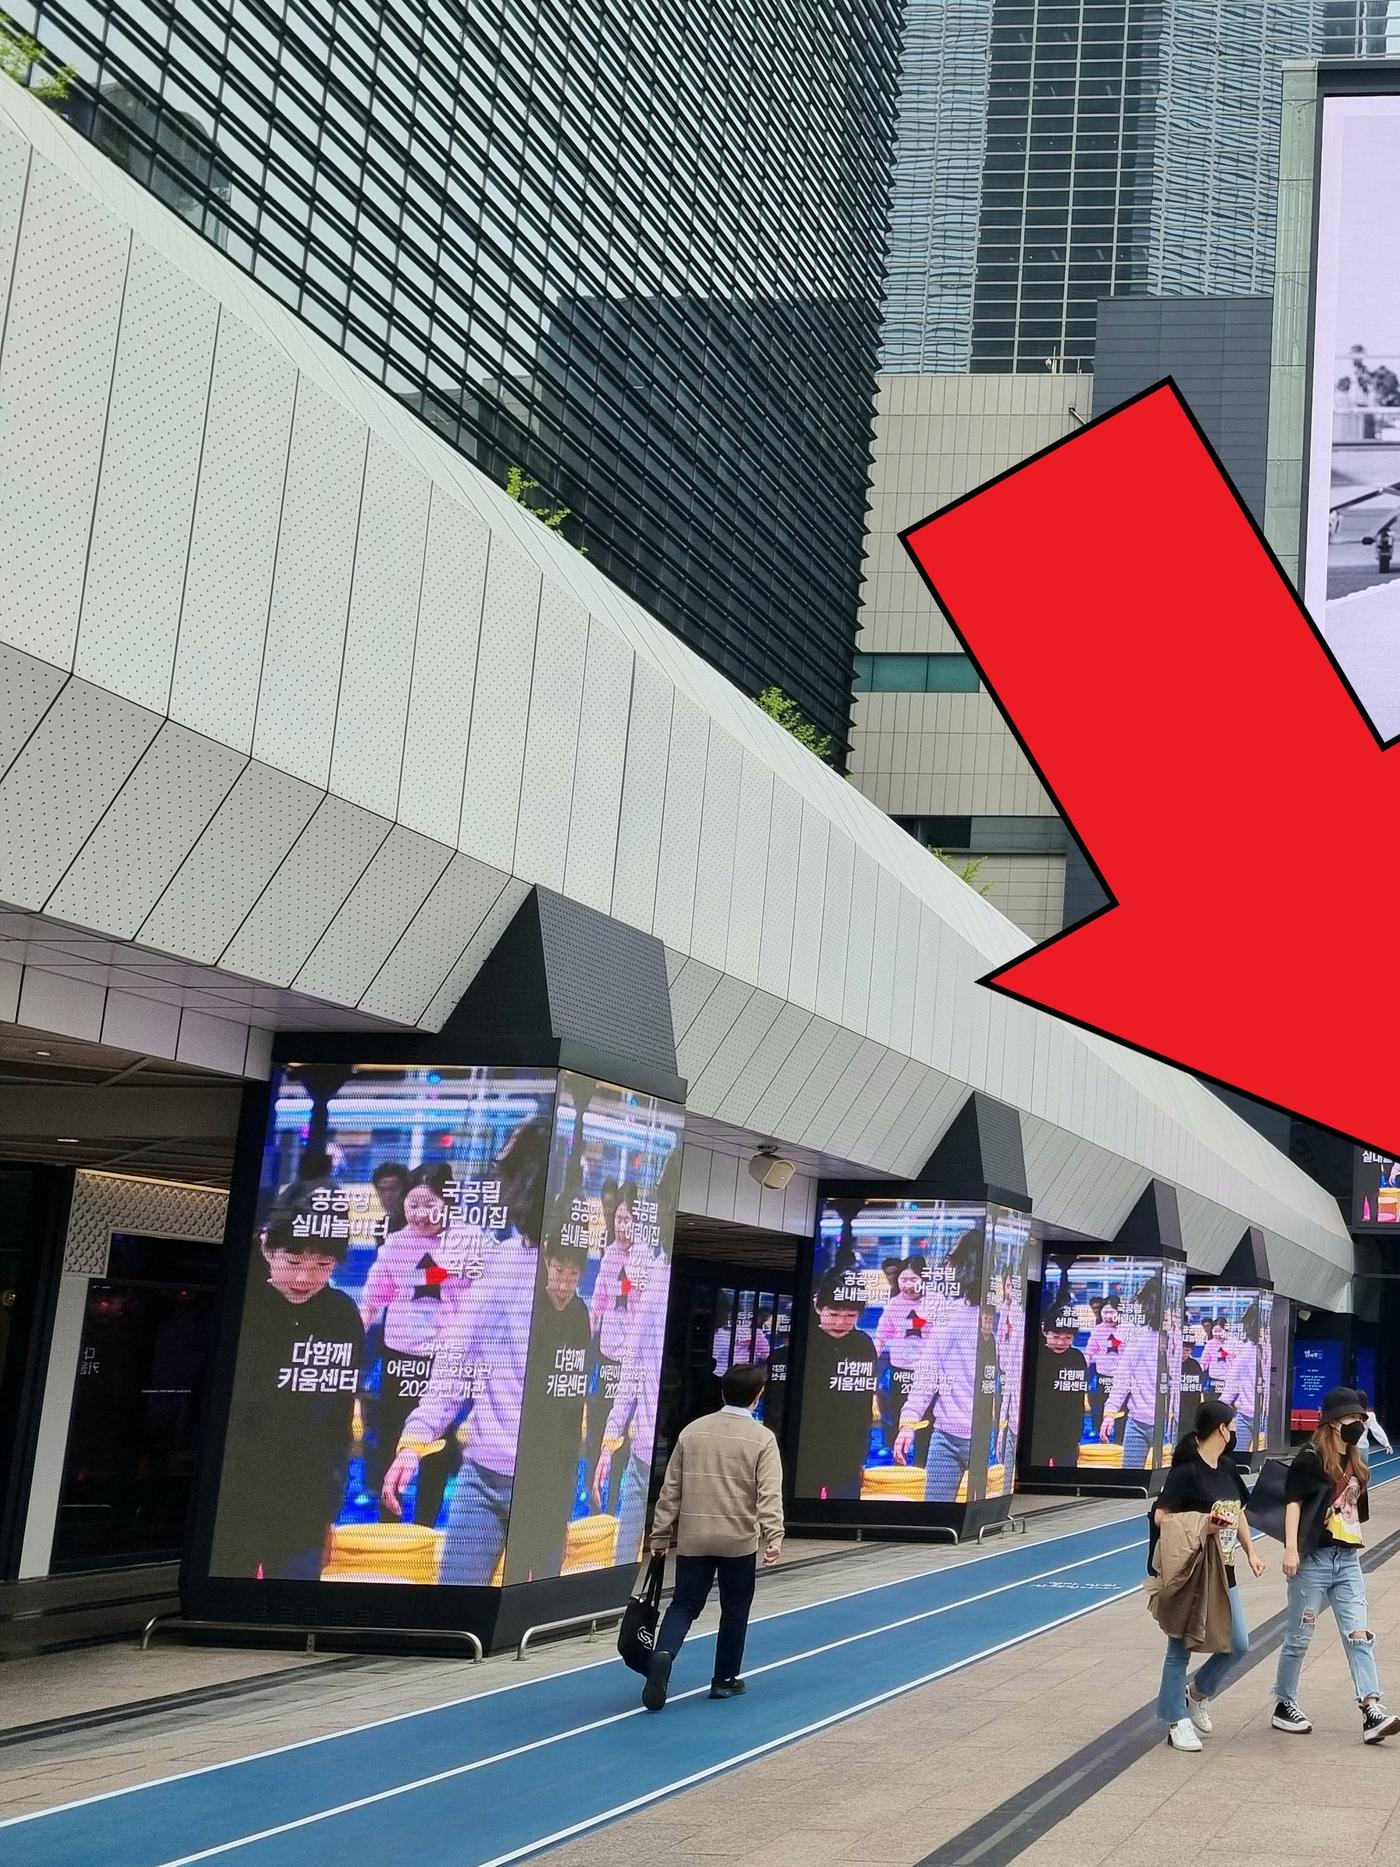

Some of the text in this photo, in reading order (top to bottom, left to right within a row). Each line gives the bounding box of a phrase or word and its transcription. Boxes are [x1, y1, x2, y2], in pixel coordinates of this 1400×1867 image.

[311, 1189, 370, 1213] 공공형
[442, 1181, 501, 1203] 국공립
[291, 1214, 390, 1239] 실내놀이터
[428, 1205, 508, 1229] 어린이집
[921, 1267, 956, 1280] 국공립
[292, 1341, 353, 1366] 다함께
[555, 1349, 585, 1371] 다함께
[386, 1360, 431, 1378] 어린이
[837, 1361, 873, 1376] 다함께
[278, 1367, 359, 1393] 키움센터
[398, 1380, 452, 1398] 2025년
[546, 1374, 587, 1398] 키움센터
[829, 1376, 877, 1392] 키움센터
[1053, 1381, 1088, 1392] 키움센터
